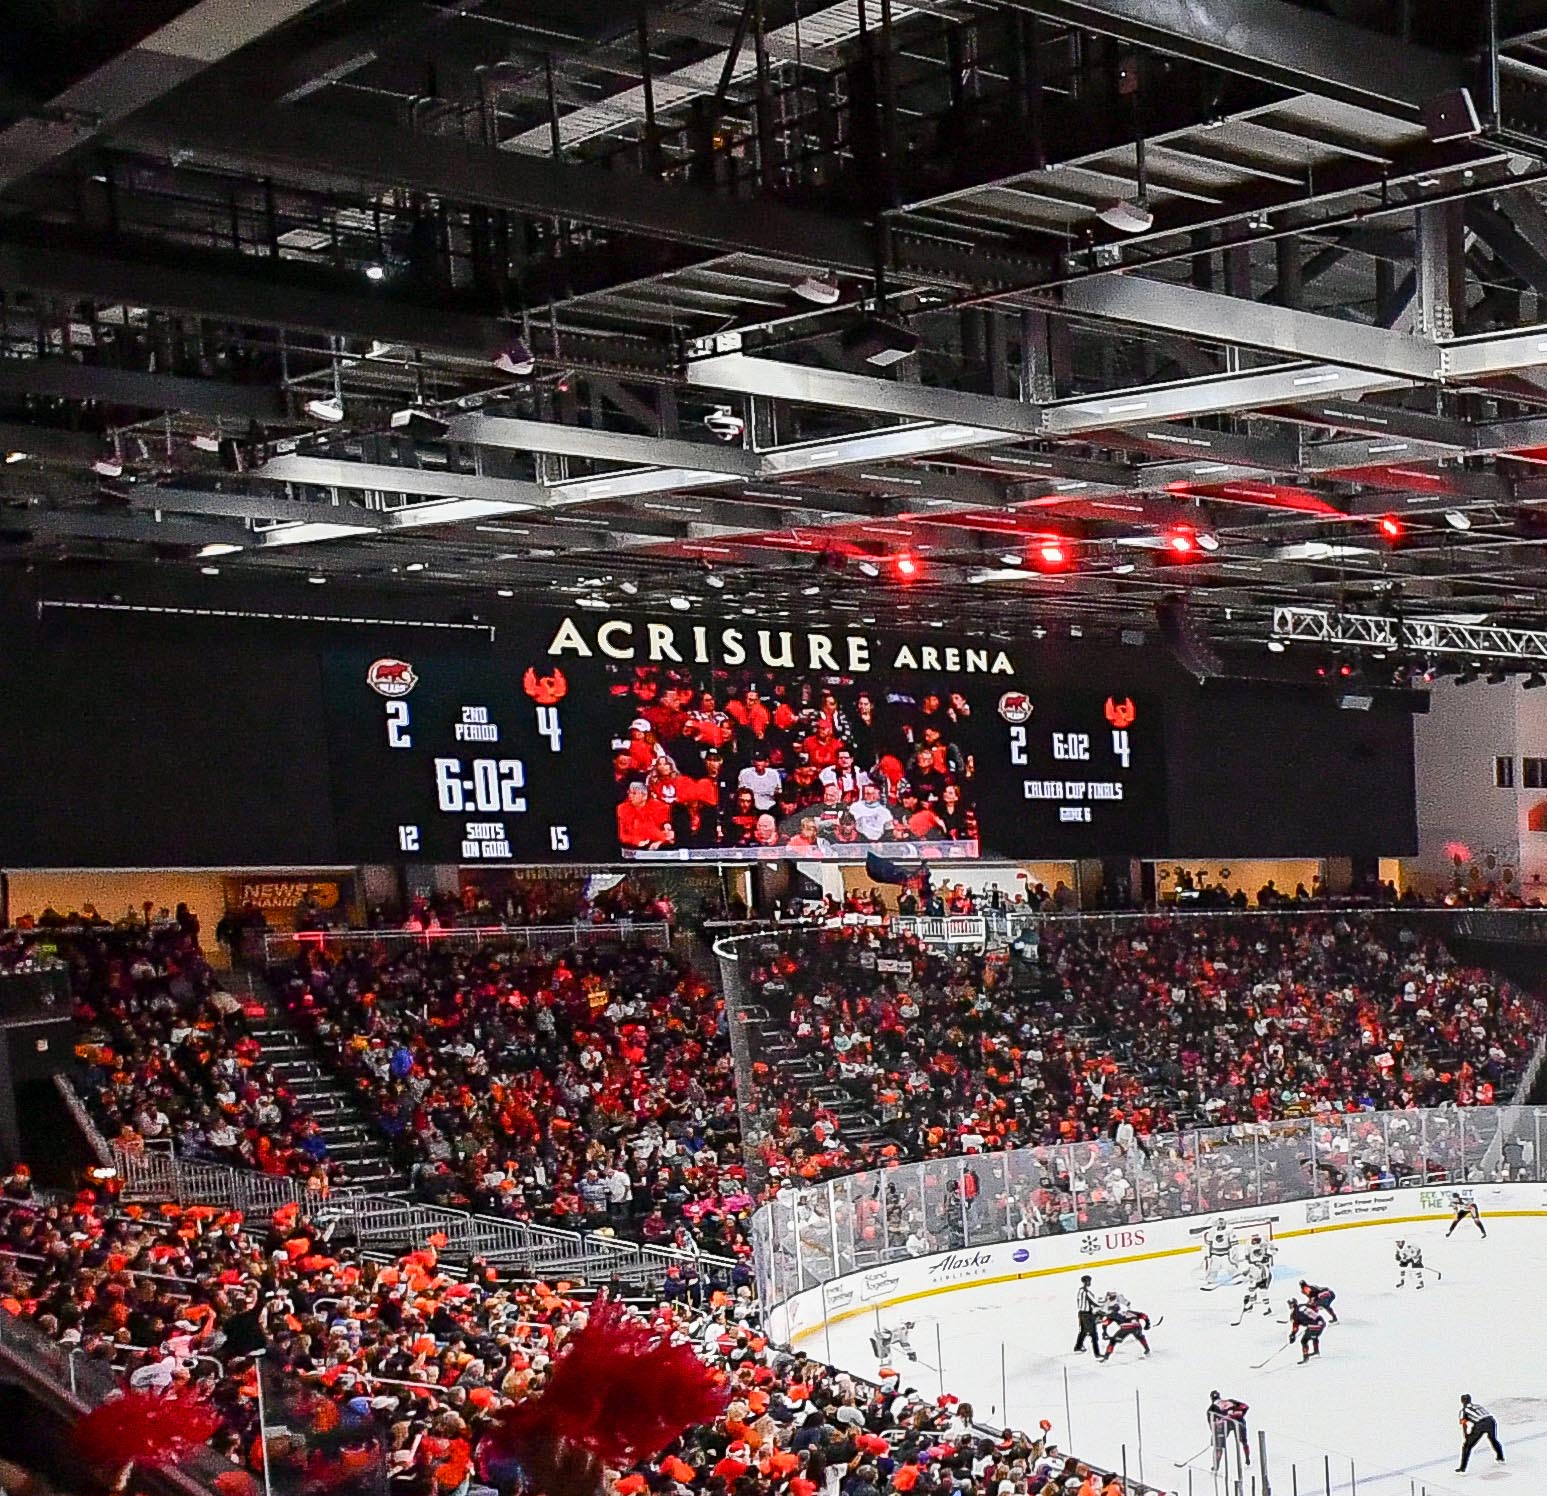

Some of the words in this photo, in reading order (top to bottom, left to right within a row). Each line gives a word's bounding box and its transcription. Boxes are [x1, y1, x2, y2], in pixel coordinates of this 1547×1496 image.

[547, 617, 872, 672] ACRISURE
[894, 643, 1015, 675] ARENA
[385, 700, 412, 748] 2
[461, 706, 488, 724] 2ND
[455, 723, 498, 742] PERIOD
[535, 706, 561, 752] 4
[1010, 726, 1028, 766] 2
[1052, 732, 1090, 761] 6:02
[1111, 730, 1131, 768] 4
[434, 758, 527, 812] 6:02
[1024, 780, 1064, 799] CALDER
[1065, 781, 1086, 799] CUP
[1087, 783, 1123, 800] FINALS
[398, 825, 421, 851] 12
[465, 822, 506, 840] SHOTS
[549, 826, 570, 851] 15
[461, 840, 480, 858] ON
[481, 840, 513, 858] GOAL
[1420, 1199, 1444, 1210] THE
[1106, 1229, 1145, 1251] UBS
[928, 1252, 993, 1275] Alaska
